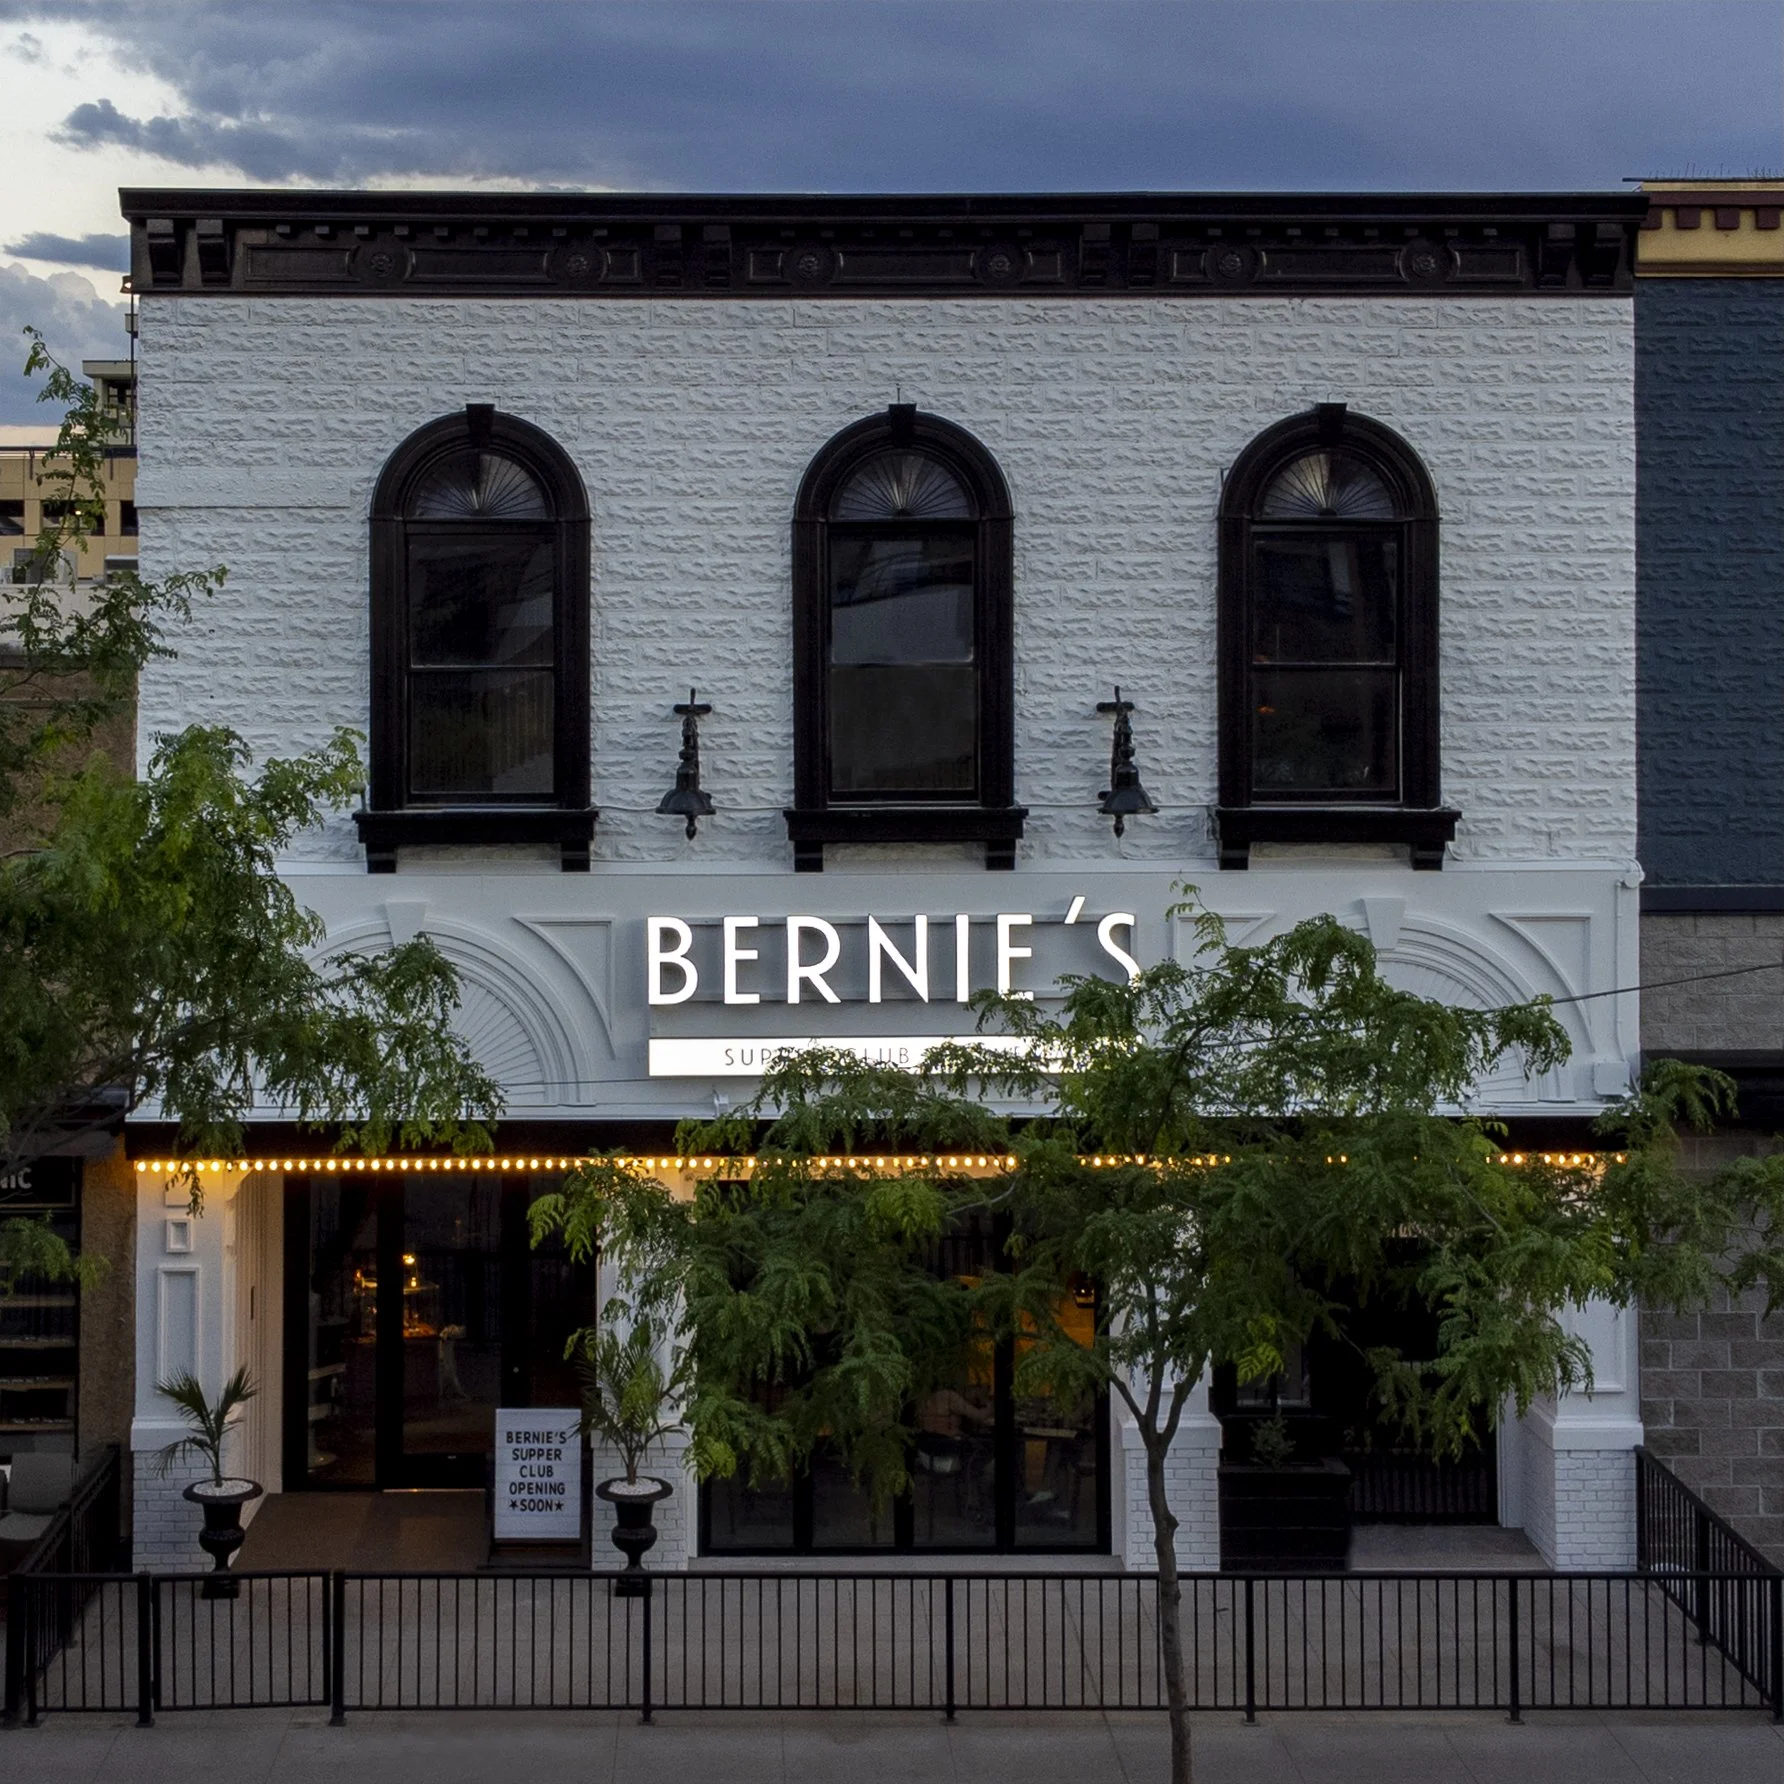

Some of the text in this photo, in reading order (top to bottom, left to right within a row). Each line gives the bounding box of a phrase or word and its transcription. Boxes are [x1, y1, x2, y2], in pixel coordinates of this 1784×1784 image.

[647, 896, 1142, 1005] BERNIE'S
[724, 1047, 828, 1067] SUP
[506, 1431, 567, 1444] BERNIE'S
[512, 1448, 562, 1461] SUPPER
[519, 1465, 554, 1478] CLUB
[509, 1482, 566, 1495] OPENING
